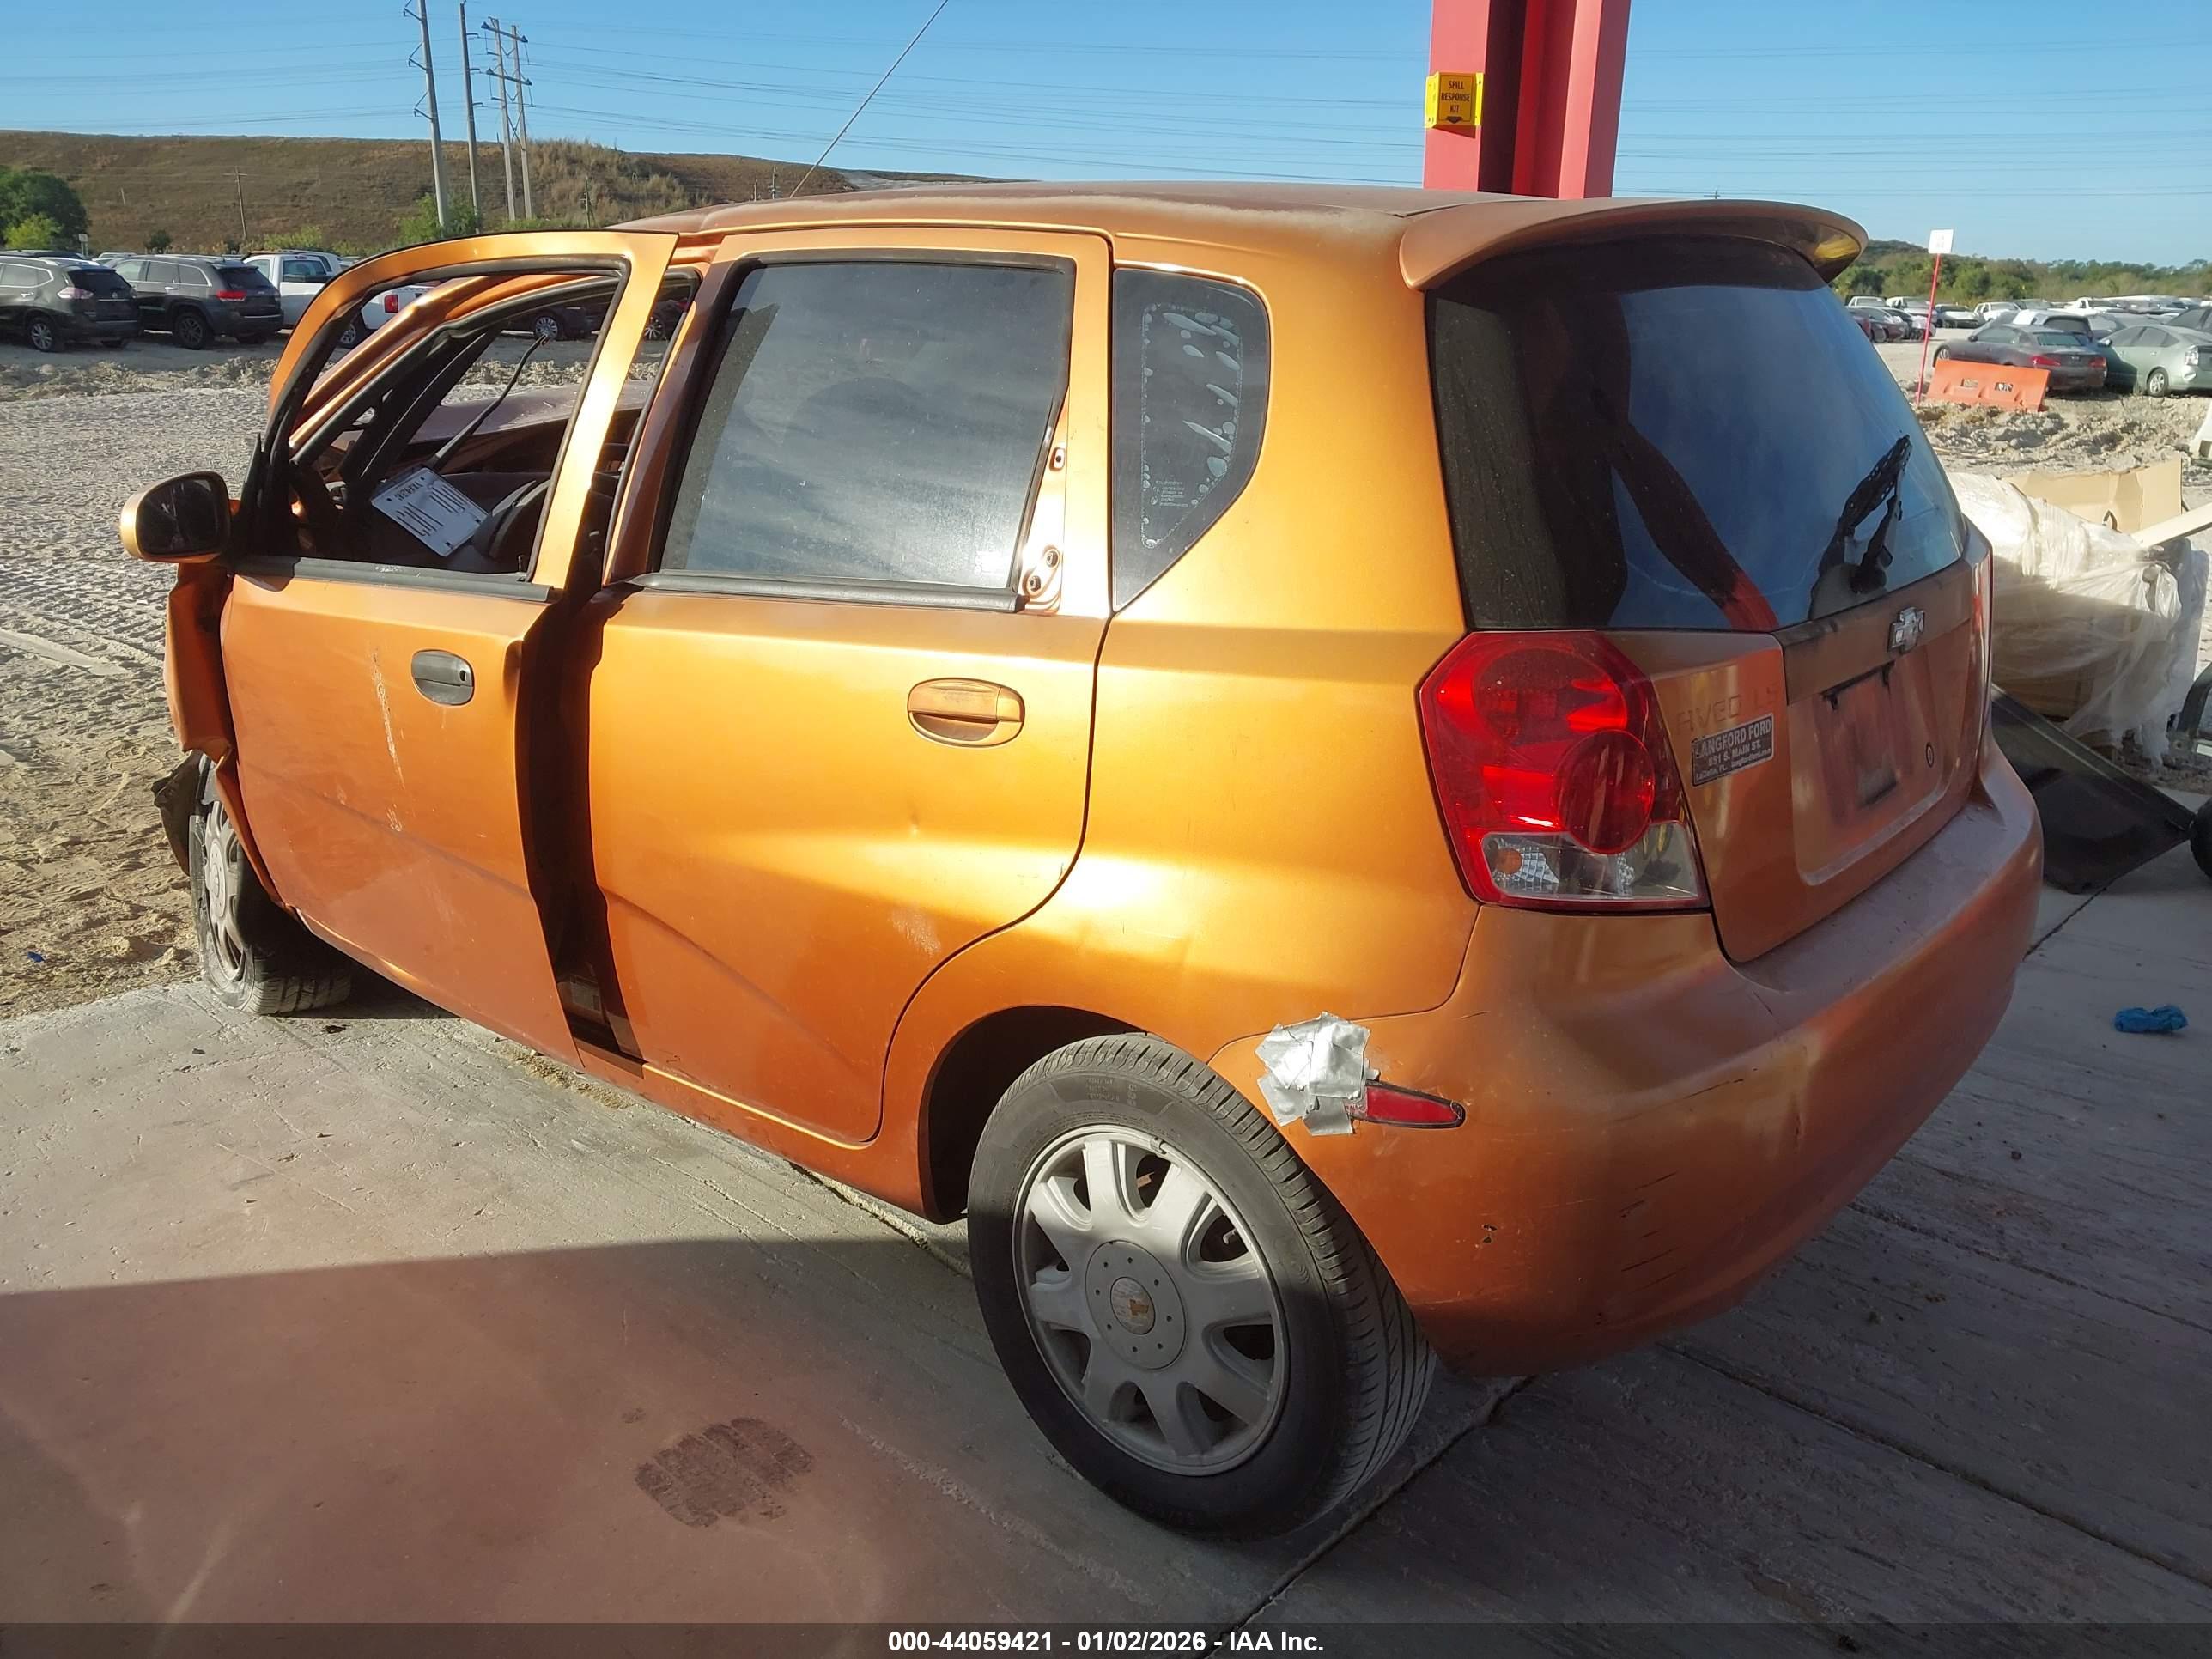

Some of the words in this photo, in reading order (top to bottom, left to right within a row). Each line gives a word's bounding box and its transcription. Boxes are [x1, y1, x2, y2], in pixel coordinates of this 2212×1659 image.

[1449, 81, 1464, 89] SPILL
[1441, 92, 1470, 102] RESPONSE
[1449, 104, 1460, 113] KIT
[1748, 719, 1771, 740] FORD
[1732, 743, 1751, 757] MAIN
